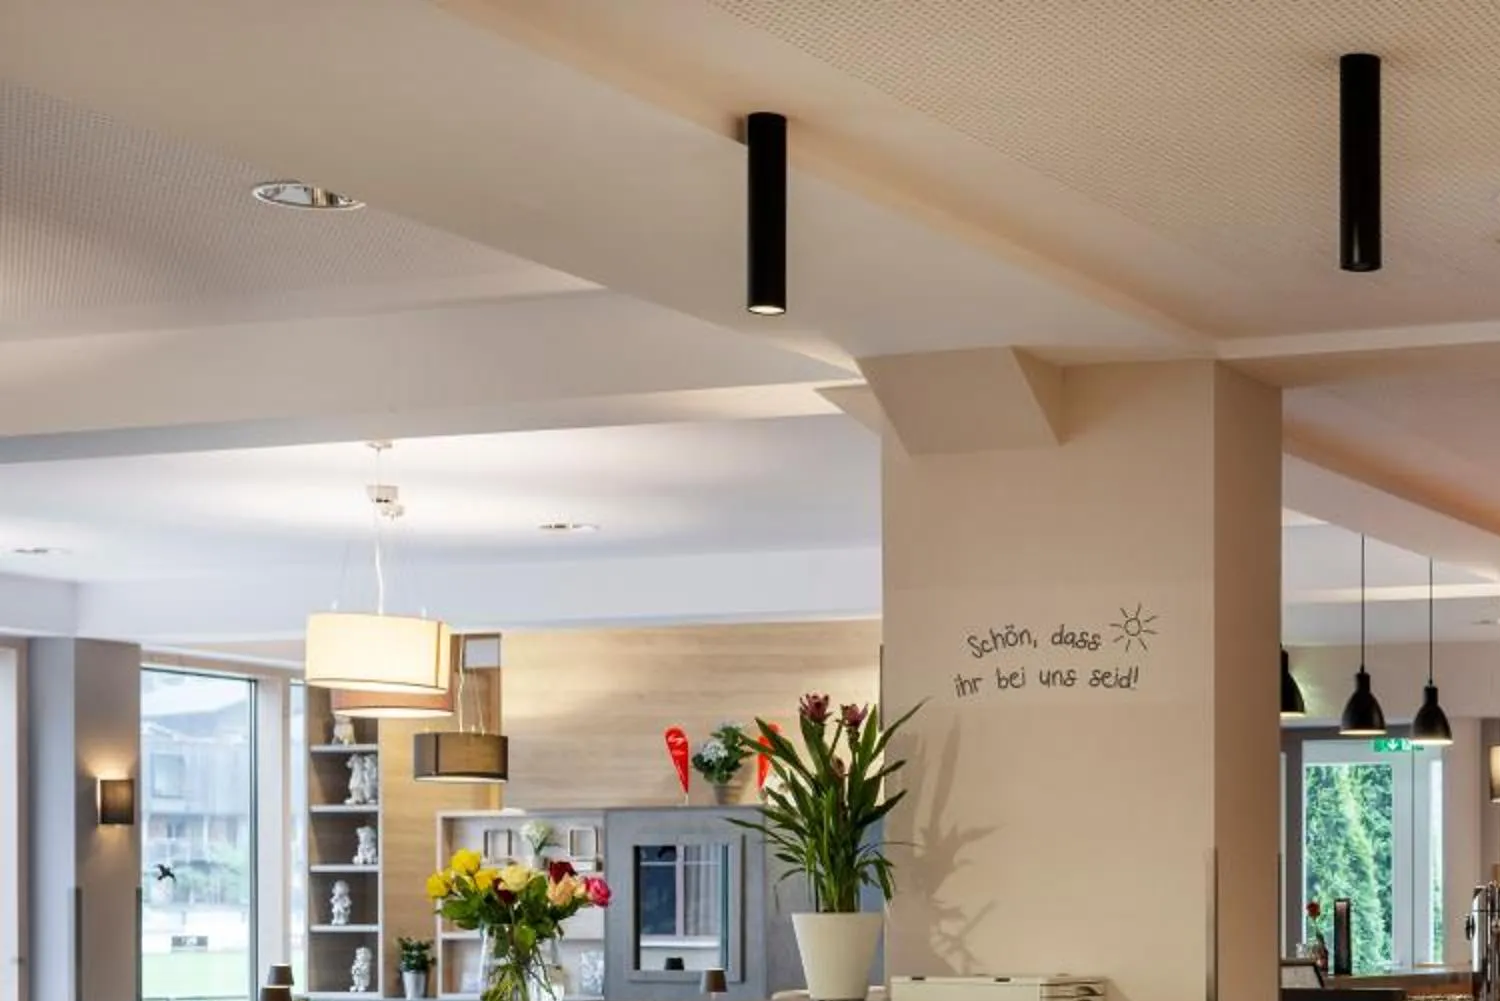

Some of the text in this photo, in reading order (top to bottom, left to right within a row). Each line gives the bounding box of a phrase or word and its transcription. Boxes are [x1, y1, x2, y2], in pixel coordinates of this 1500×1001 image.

[967, 623, 1102, 658] Schön, dass
[954, 666, 1139, 697] ihr bei uns seid!
